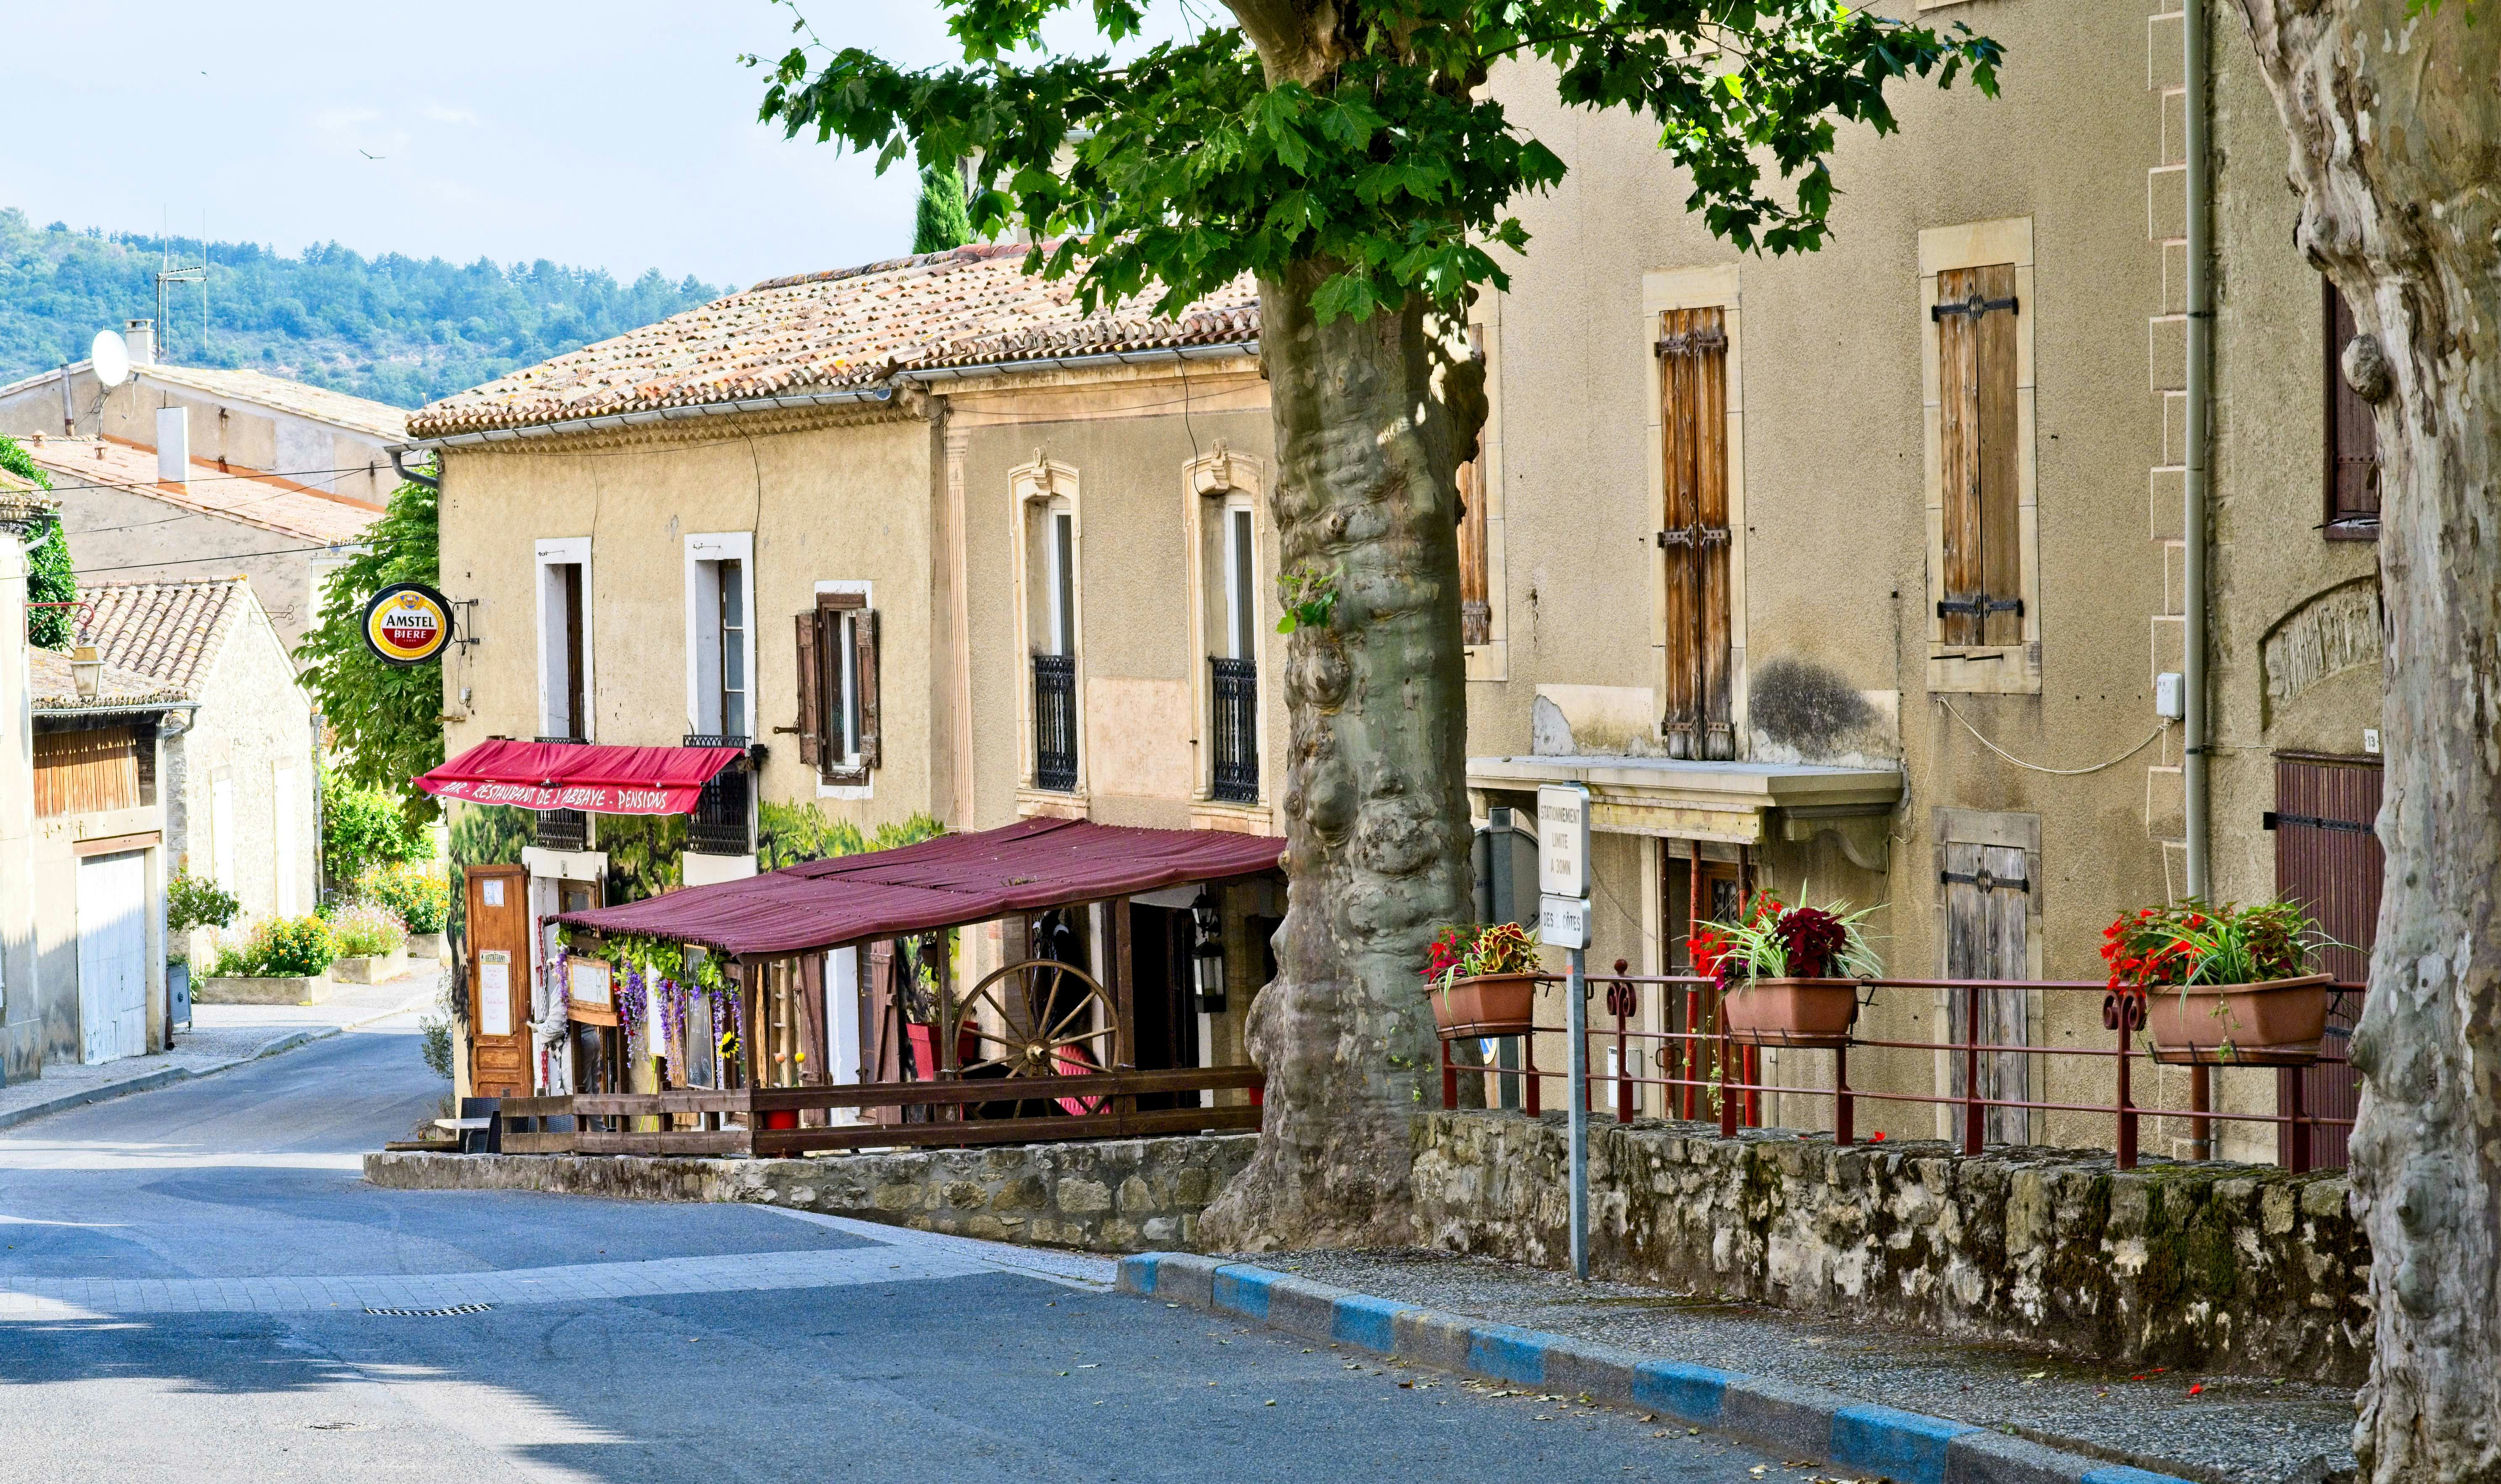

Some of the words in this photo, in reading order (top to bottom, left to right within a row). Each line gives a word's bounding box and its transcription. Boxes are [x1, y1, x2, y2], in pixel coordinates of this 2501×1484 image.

[387, 615, 434, 626] AMSTEL
[394, 630, 426, 639] BIERE
[2367, 735, 2375, 747] 13
[440, 782, 468, 794] BAR
[472, 784, 537, 803] RESTAURANT
[536, 788, 553, 805] DE
[618, 790, 668, 810] PENSIONS
[1540, 805, 1580, 824] STATIONNEMENT
[1552, 832, 1568, 849] LIMITE
[1551, 858, 1554, 873] A
[1556, 858, 1571, 875] 30MN
[1543, 911, 1553, 927] DES
[1563, 911, 1580, 931] CÔTES
